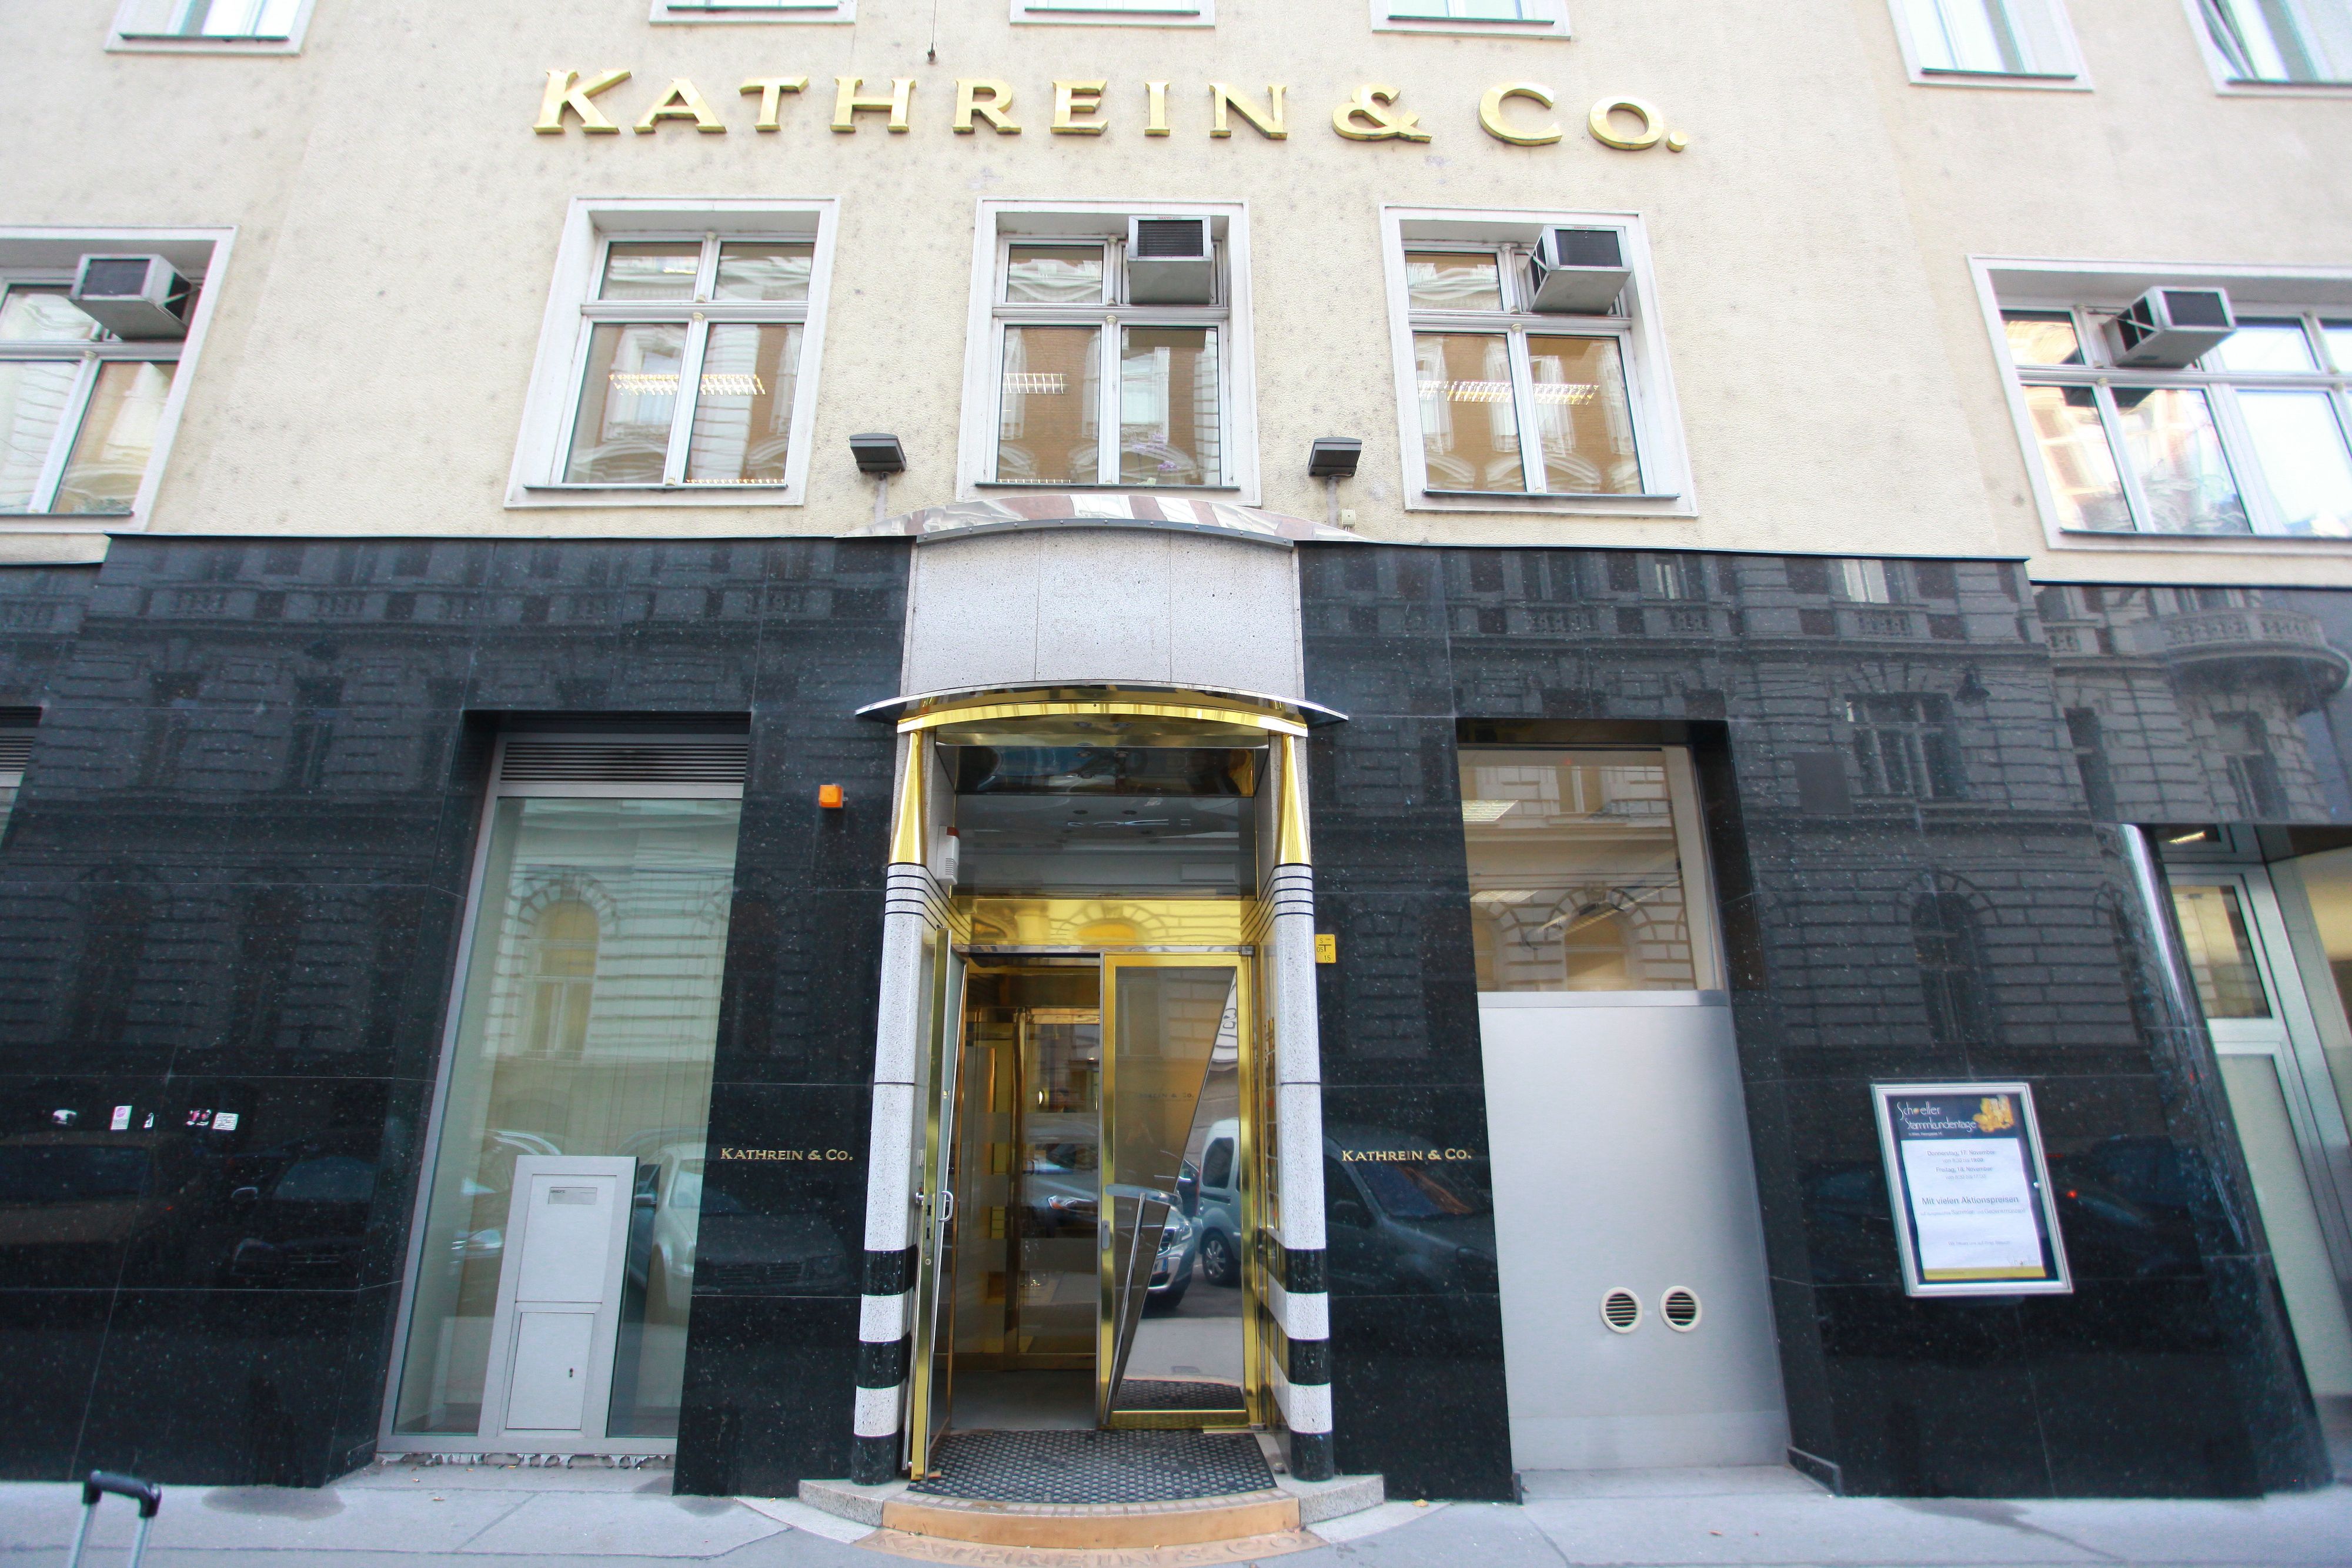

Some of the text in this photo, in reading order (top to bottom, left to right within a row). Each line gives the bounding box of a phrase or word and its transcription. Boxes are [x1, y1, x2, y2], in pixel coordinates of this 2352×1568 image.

[532, 69, 1689, 153] KATHREIN & CO.
[1905, 1116, 1976, 1132] Stammkundentage
[720, 1148, 853, 1161] KATHREIN & CO.
[1342, 1148, 1472, 1162] KATHREIN & CO.
[1922, 1195, 2019, 1205] Mit vielen Aktionspreisen
